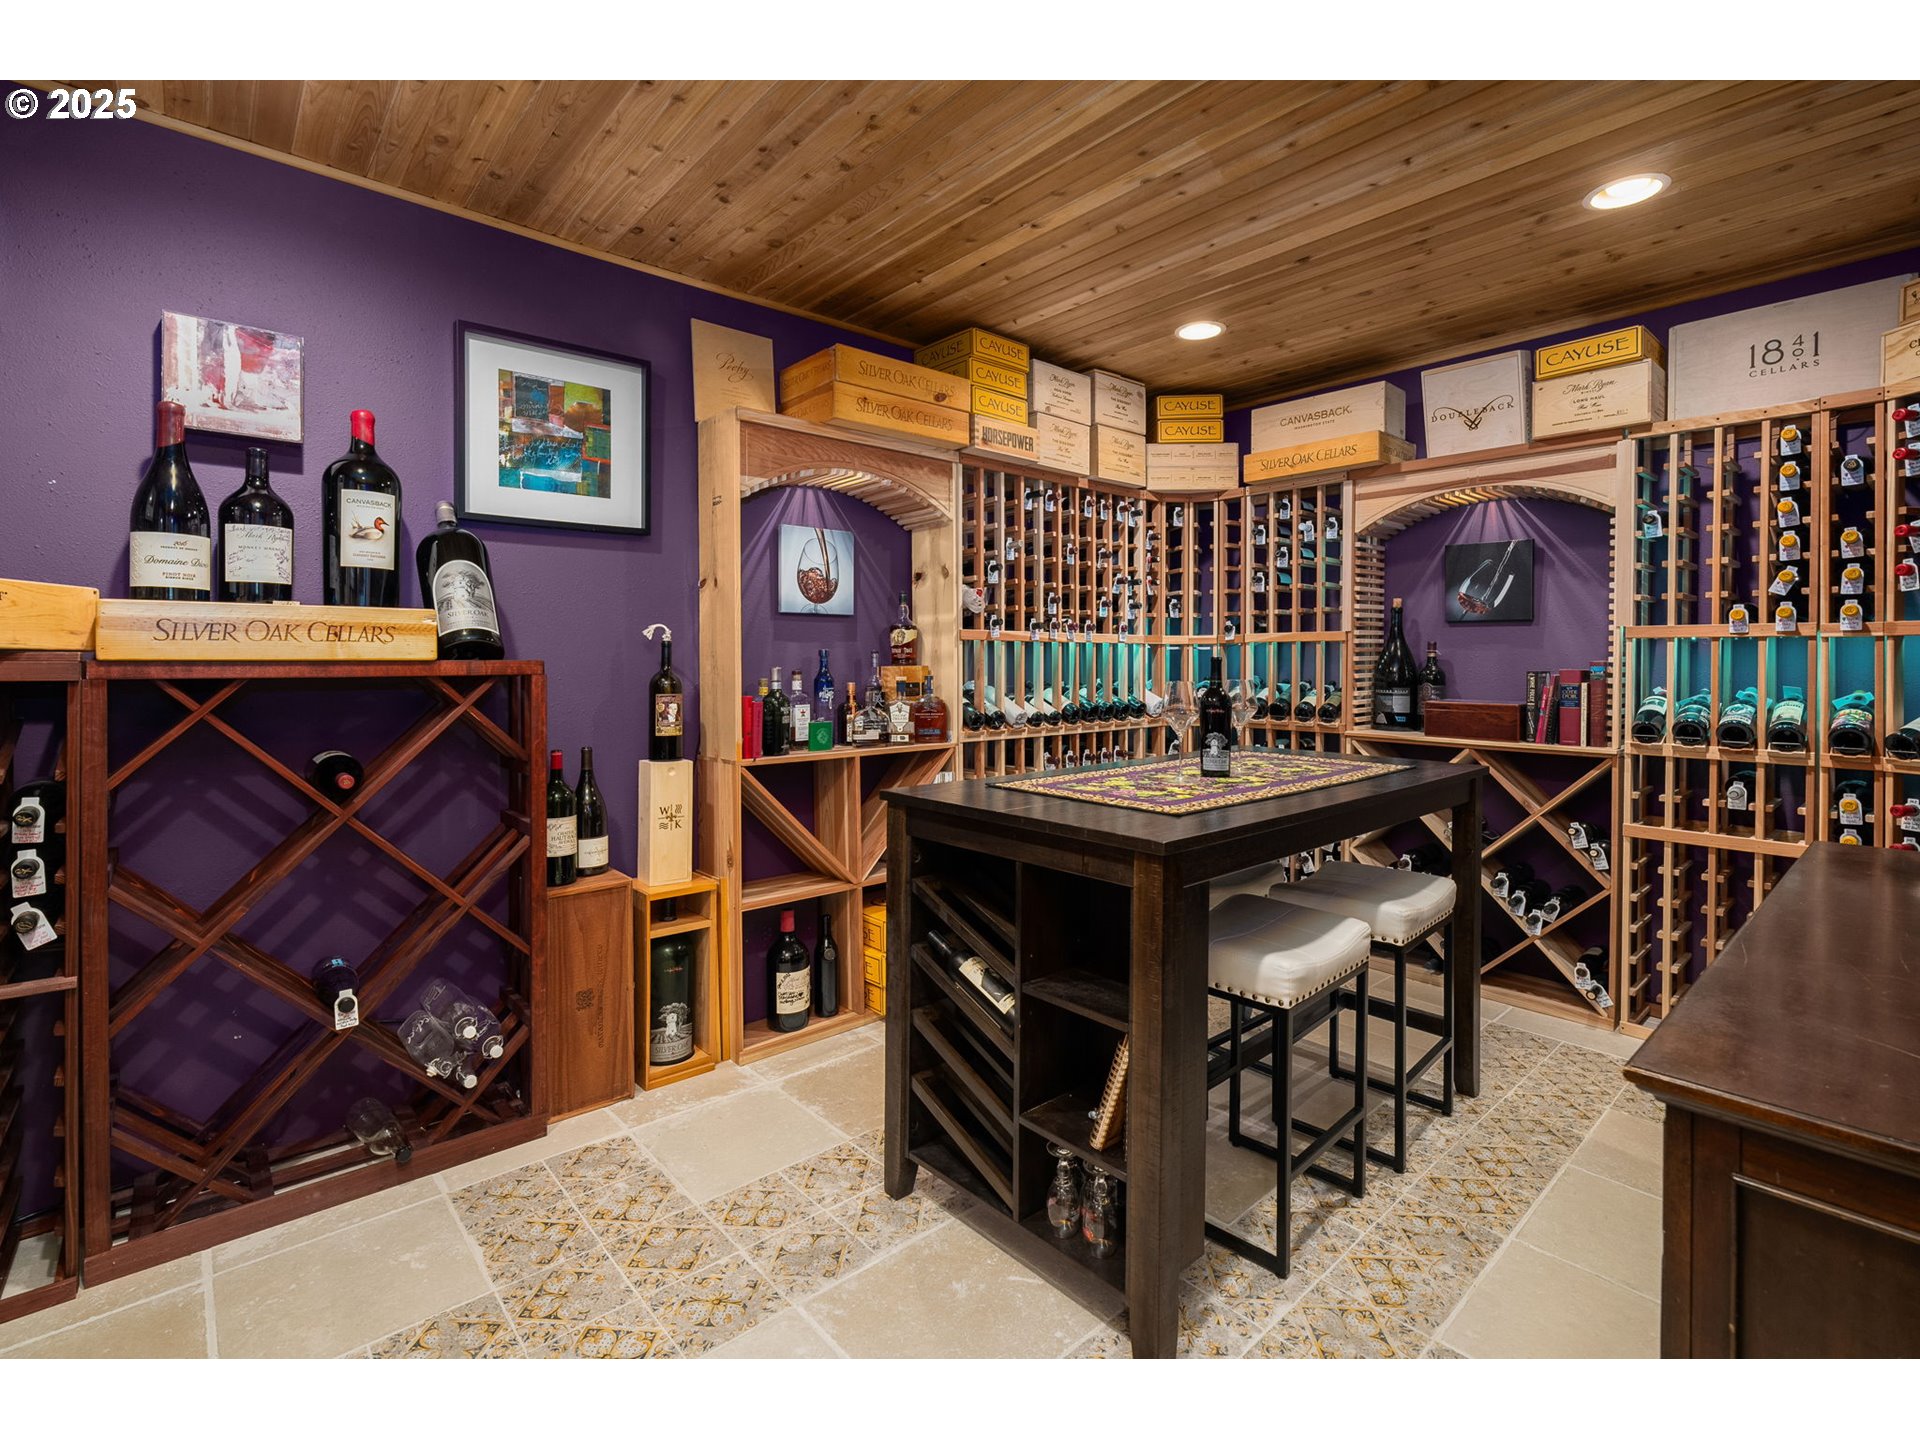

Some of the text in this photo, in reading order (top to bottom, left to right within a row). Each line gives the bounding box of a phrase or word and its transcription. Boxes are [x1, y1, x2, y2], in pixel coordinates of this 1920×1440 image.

[922, 341, 964, 366] CAYUSE
[980, 337, 1024, 360] CAYUSE
[1546, 337, 1630, 366] CAYUSE
[858, 360, 956, 397] SILVER OAK CELLARS
[976, 368, 1021, 389] CAYUSE
[1749, 360, 1820, 378] CELLARS
[1562, 382, 1589, 394] Mark
[856, 397, 953, 431] SILVER OAK CELLARS
[979, 396, 1024, 416] CAYUSE
[1164, 400, 1216, 411] CAYUSE
[1431, 400, 1515, 423] DOUBLEBACK
[982, 426, 1034, 452] HORSEPOWER
[1165, 425, 1216, 436] CAYUSE
[1260, 444, 1358, 472] SILVER OAK CELLARS
[346, 497, 392, 508] CANVASBACK
[144, 554, 188, 566] Domaine
[447, 610, 489, 618] SILVER OAK
[152, 618, 397, 644] SILVER OAK CELLARS
[659, 806, 670, 815] W
[675, 820, 682, 829] K
